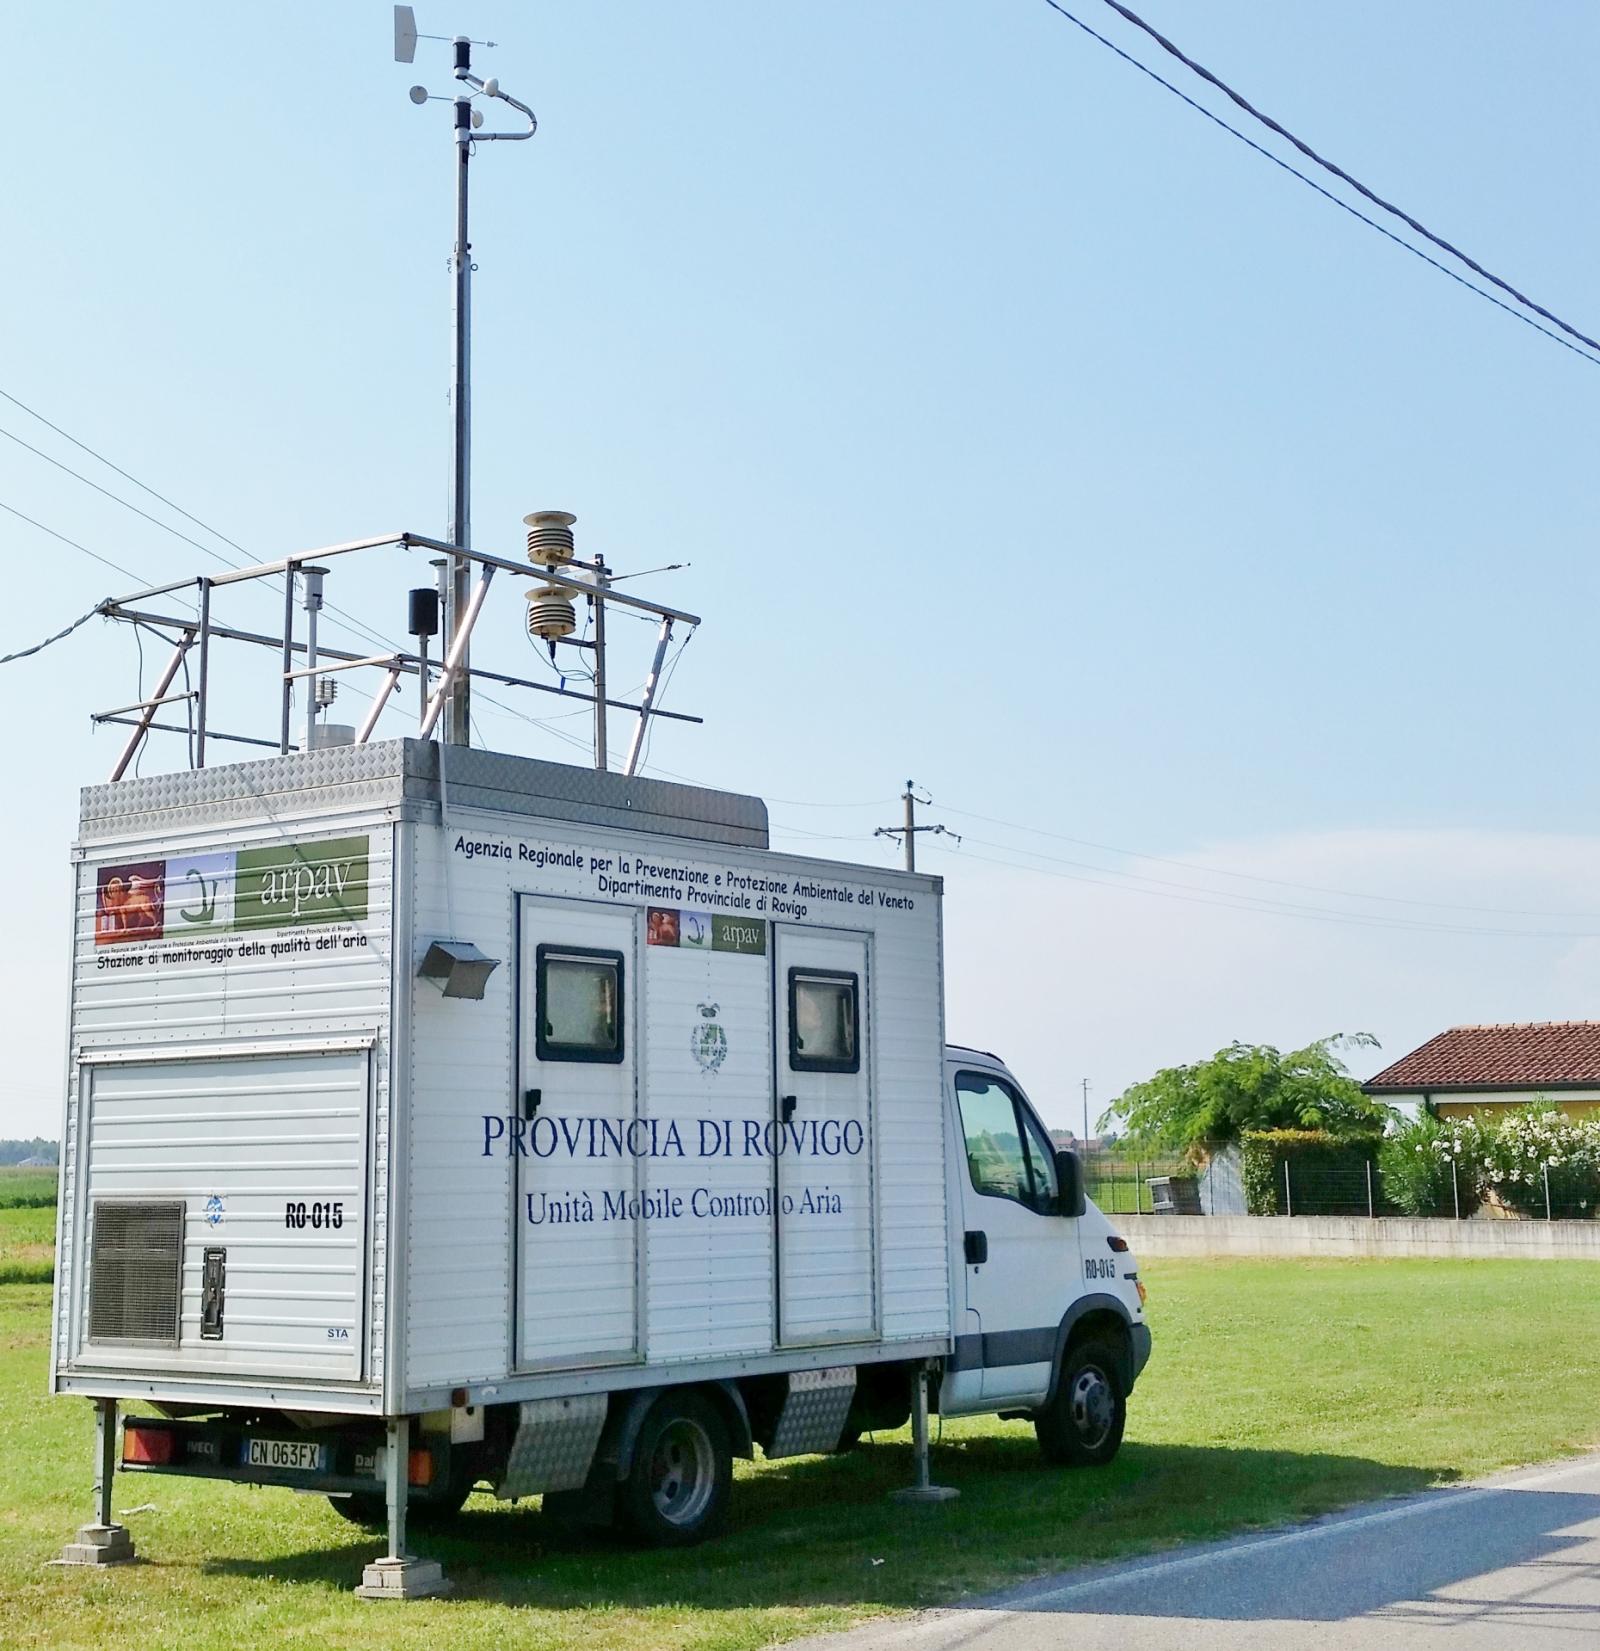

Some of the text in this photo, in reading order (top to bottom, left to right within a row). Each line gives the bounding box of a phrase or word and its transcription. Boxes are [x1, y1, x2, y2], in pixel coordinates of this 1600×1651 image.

[261, 861, 352, 917] arpav
[454, 835, 914, 911] Agenzia Regionale per la Prevenzione e Protezione Ambientale del Veneto
[598, 875, 808, 919] Dipartimento Provinciale di Rovigo
[97, 932, 367, 969] Stazione di monitoraggio della qualità dell'aria
[722, 924, 760, 949] arpav
[481, 1115, 864, 1158] PROVINCIA DI ROVIGO
[286, 1202, 343, 1229] RO-015
[526, 1191, 594, 1225] Unità
[602, 1188, 684, 1221] Mobile
[799, 1185, 842, 1215] Aria
[327, 1328, 348, 1338] STA
[252, 1441, 268, 1464] CN
[272, 1443, 317, 1468] 063FX
